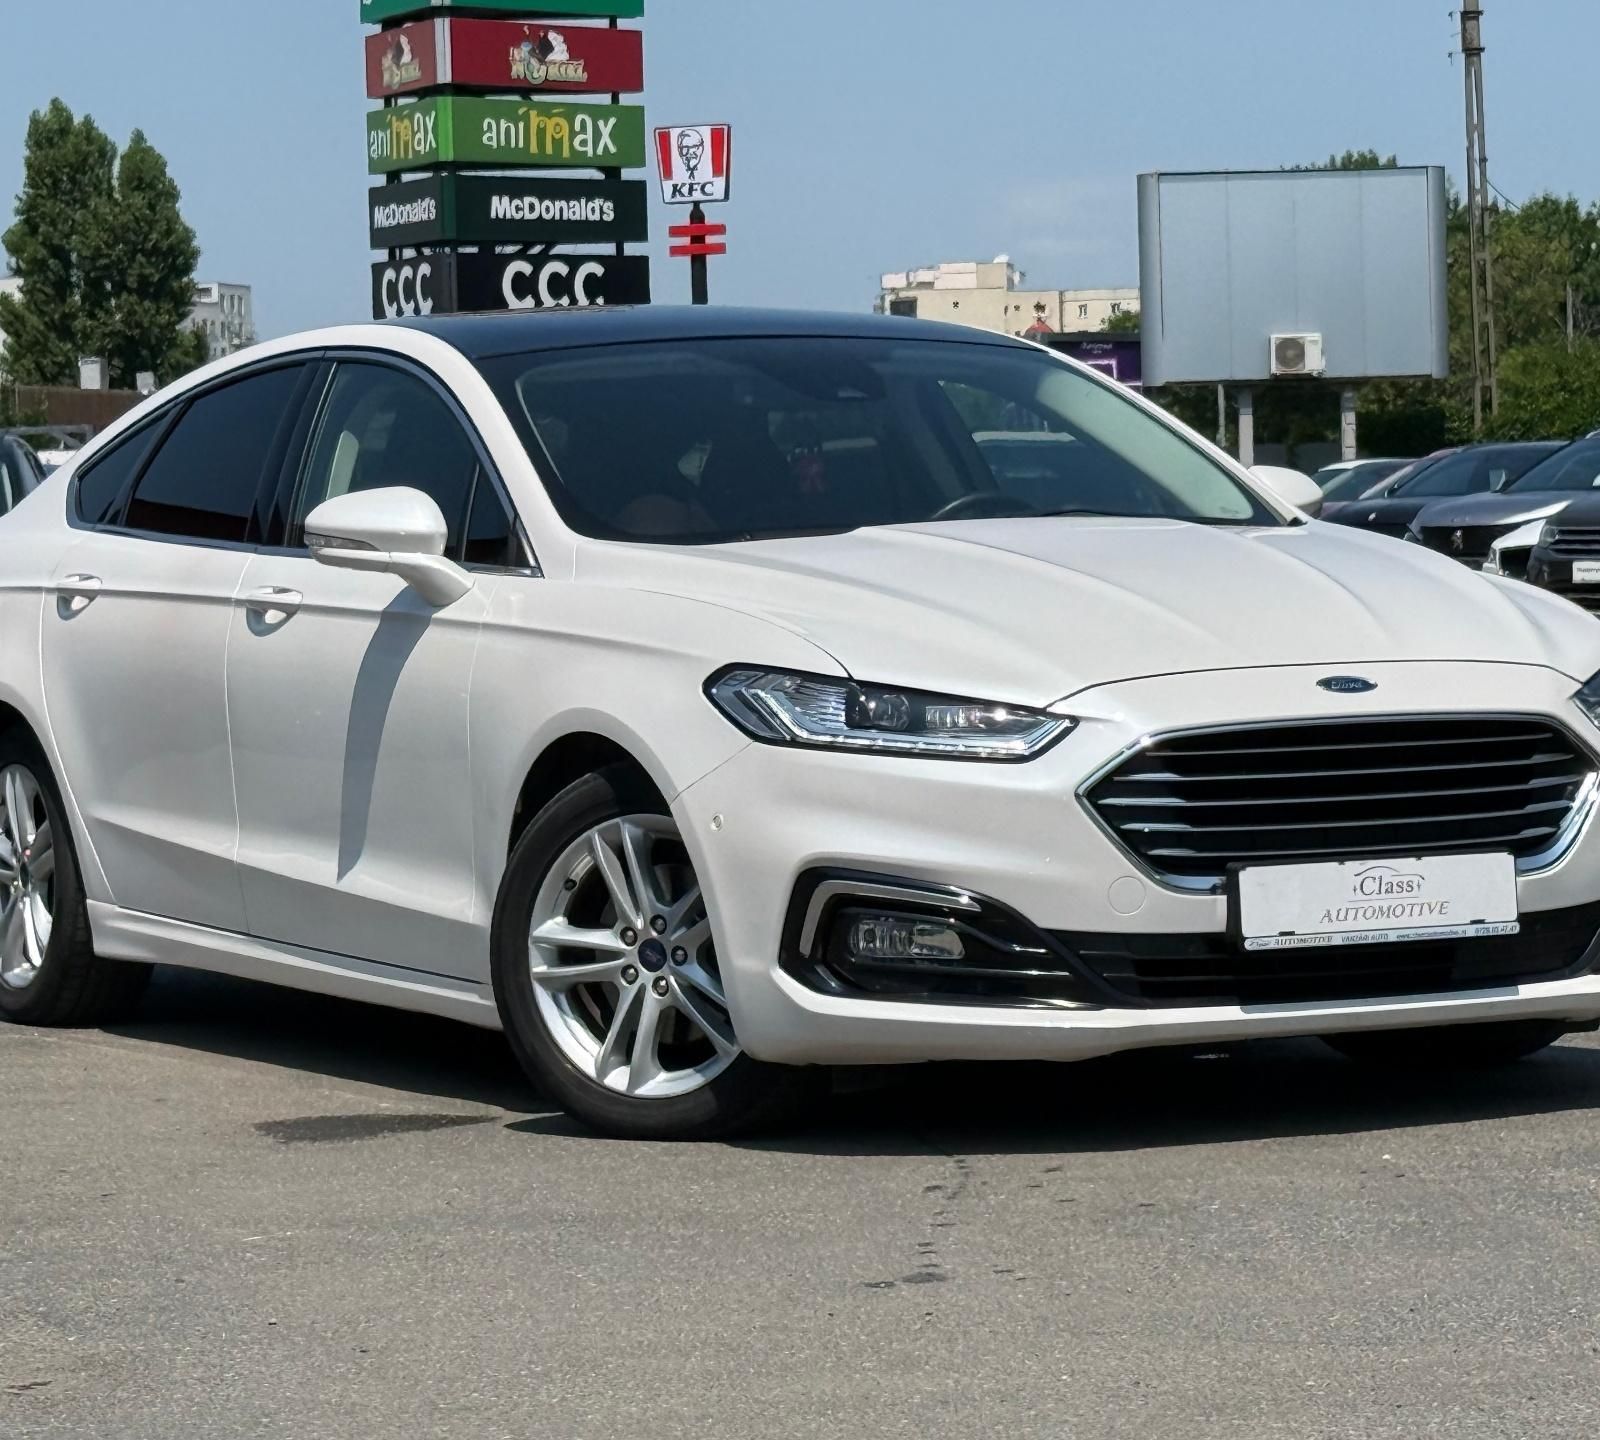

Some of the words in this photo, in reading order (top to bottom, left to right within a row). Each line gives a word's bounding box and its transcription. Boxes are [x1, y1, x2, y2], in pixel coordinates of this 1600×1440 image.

[370, 110, 437, 161] animax
[482, 107, 617, 158] animax
[671, 181, 714, 199] KFC
[374, 197, 436, 229] McDonald's
[490, 195, 615, 222] McDonald's
[382, 262, 433, 319] CCC
[502, 260, 605, 309] CCC
[1360, 875, 1414, 896] Class
[1320, 901, 1450, 923] AUTOMOTIVE
